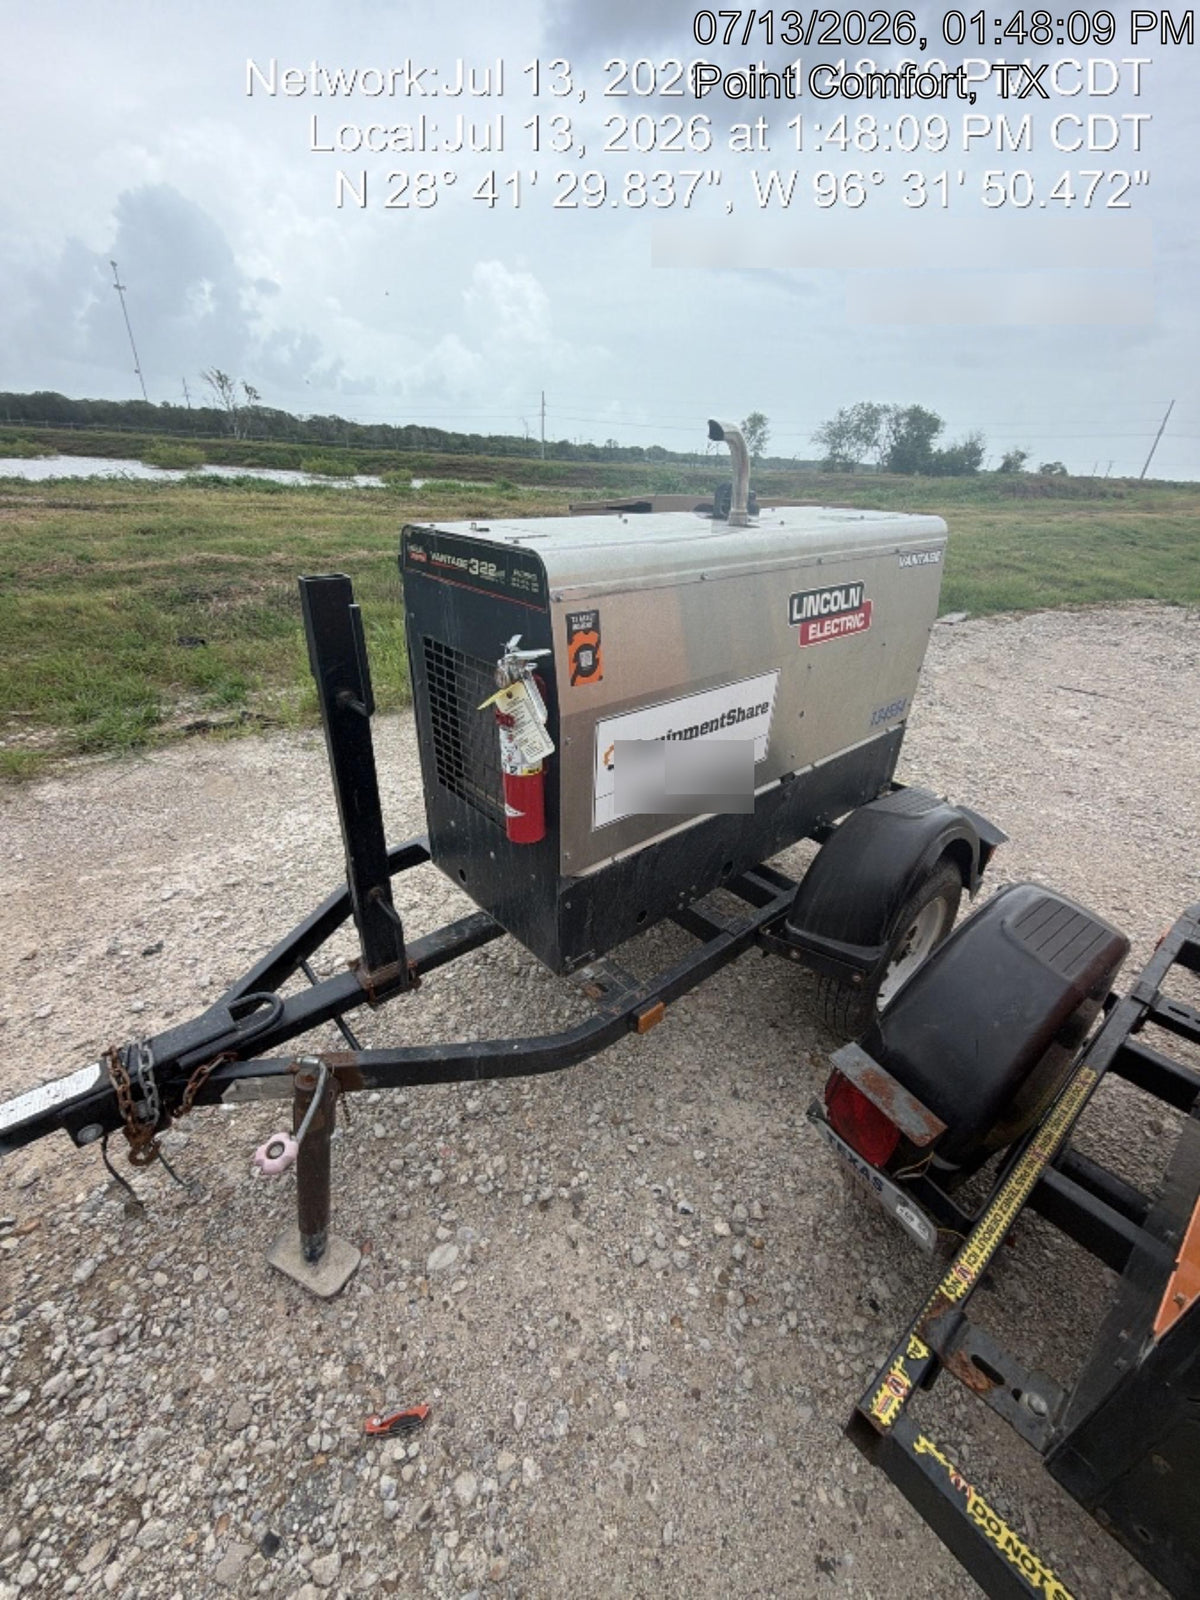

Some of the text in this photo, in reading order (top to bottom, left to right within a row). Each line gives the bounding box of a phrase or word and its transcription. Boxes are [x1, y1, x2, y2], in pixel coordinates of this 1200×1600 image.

[468, 557, 497, 577] 322
[899, 550, 942, 569] VANTAGE
[792, 586, 862, 621] LINCOLN
[808, 612, 866, 641] ELECTRIC
[826, 1129, 884, 1192] TEXAS
[972, 1501, 1002, 1535] DO
[1004, 1536, 1051, 1585] NOT
